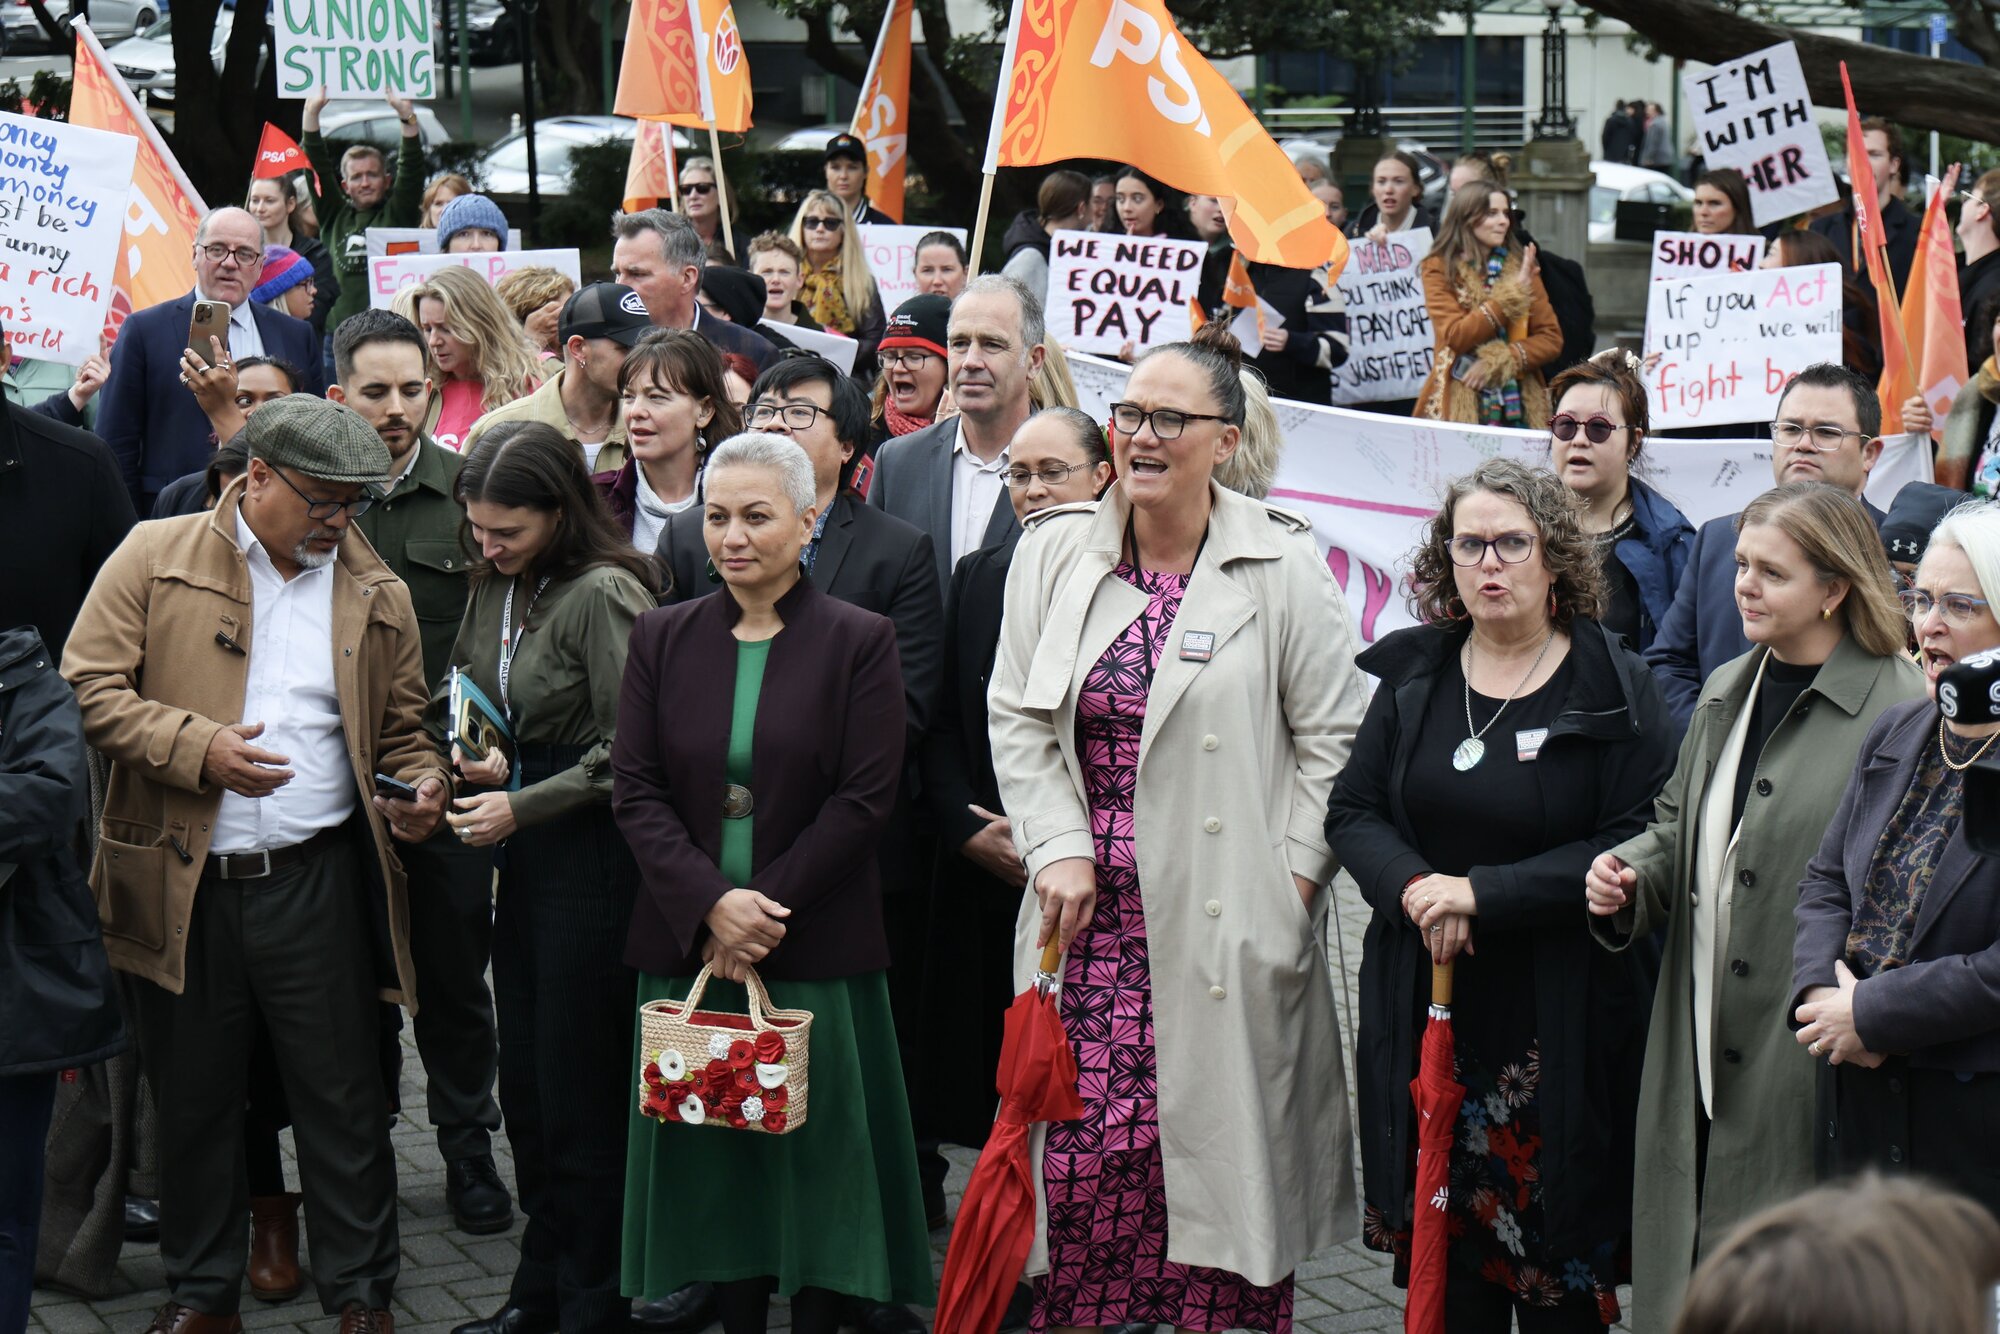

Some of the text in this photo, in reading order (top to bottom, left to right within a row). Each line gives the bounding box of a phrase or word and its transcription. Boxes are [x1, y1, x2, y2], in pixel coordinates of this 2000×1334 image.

[284, 0, 429, 43] UNION
[284, 45, 432, 97] STRONG
[1090, 0, 1211, 138] PS
[1697, 58, 1775, 114] I'M
[866, 74, 907, 178] SA
[1705, 99, 1808, 152] WITH
[0, 148, 69, 190] oney
[261, 151, 286, 163] PSA
[0, 176, 98, 227] money
[37, 205, 68, 232] be
[1058, 239, 1199, 272] WE NEED
[1355, 242, 1413, 275] MAD
[1657, 239, 1756, 271] SHOW
[28, 271, 99, 302] rich
[1067, 268, 1186, 306] EQUAL
[1337, 277, 1421, 306] OU THINK
[1665, 269, 1828, 329] If you Act
[1071, 298, 1162, 344] PAY
[1357, 311, 1394, 346] PAY
[1664, 331, 1701, 361] up
[1760, 322, 1797, 338] we
[1805, 309, 1842, 334] will
[1656, 360, 1743, 418] fight
